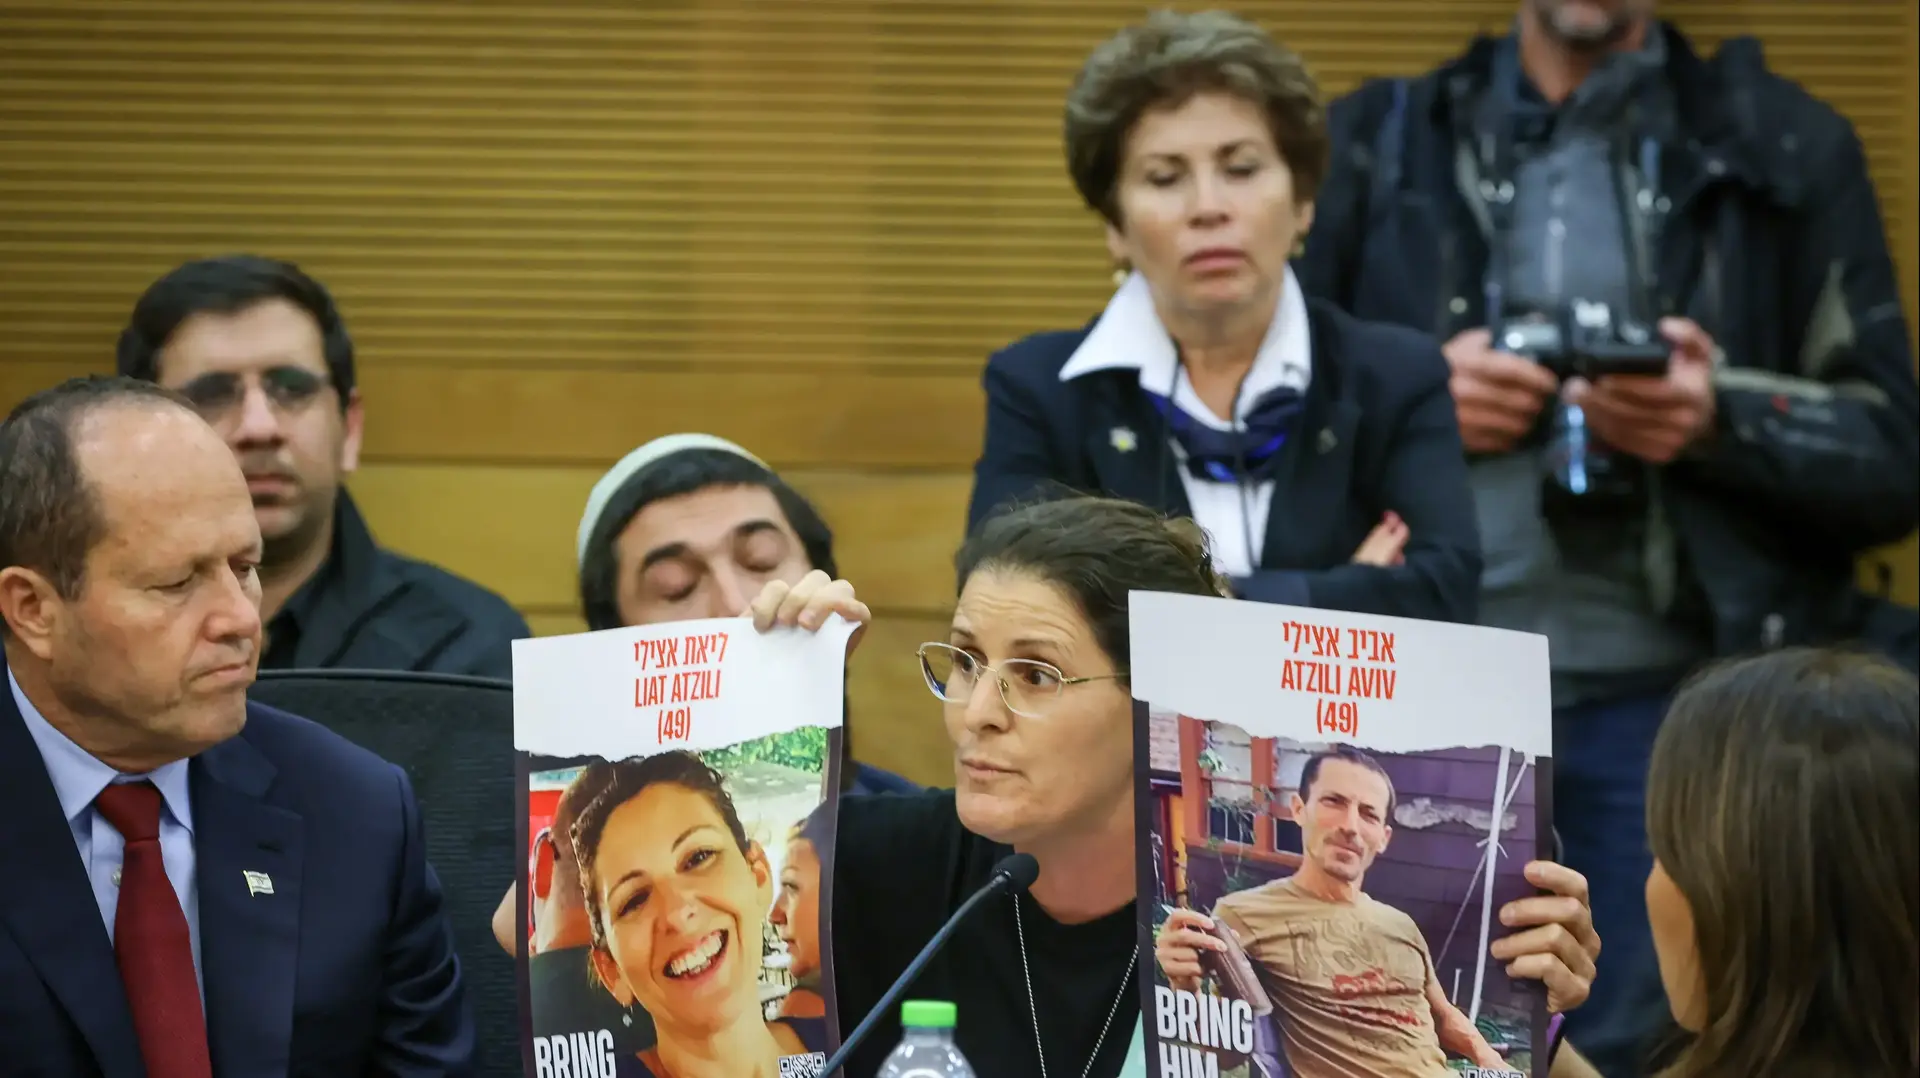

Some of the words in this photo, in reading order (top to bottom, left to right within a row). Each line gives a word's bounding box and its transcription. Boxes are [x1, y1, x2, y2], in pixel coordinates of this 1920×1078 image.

[634, 638, 679, 670] אצילי
[683, 632, 729, 665] ליאת
[1282, 621, 1340, 658] אצילי
[1347, 628, 1396, 663] אביב
[634, 674, 668, 708] LIAT
[671, 670, 721, 703] ATZILI
[1281, 658, 1342, 696] ATZILI
[1347, 666, 1397, 700] AVIV
[657, 706, 691, 745] (49)
[1316, 699, 1359, 737] (49)
[1154, 984, 1254, 1054] BRING
[533, 1028, 617, 1078] BRING
[1157, 1041, 1220, 1078] HIM
